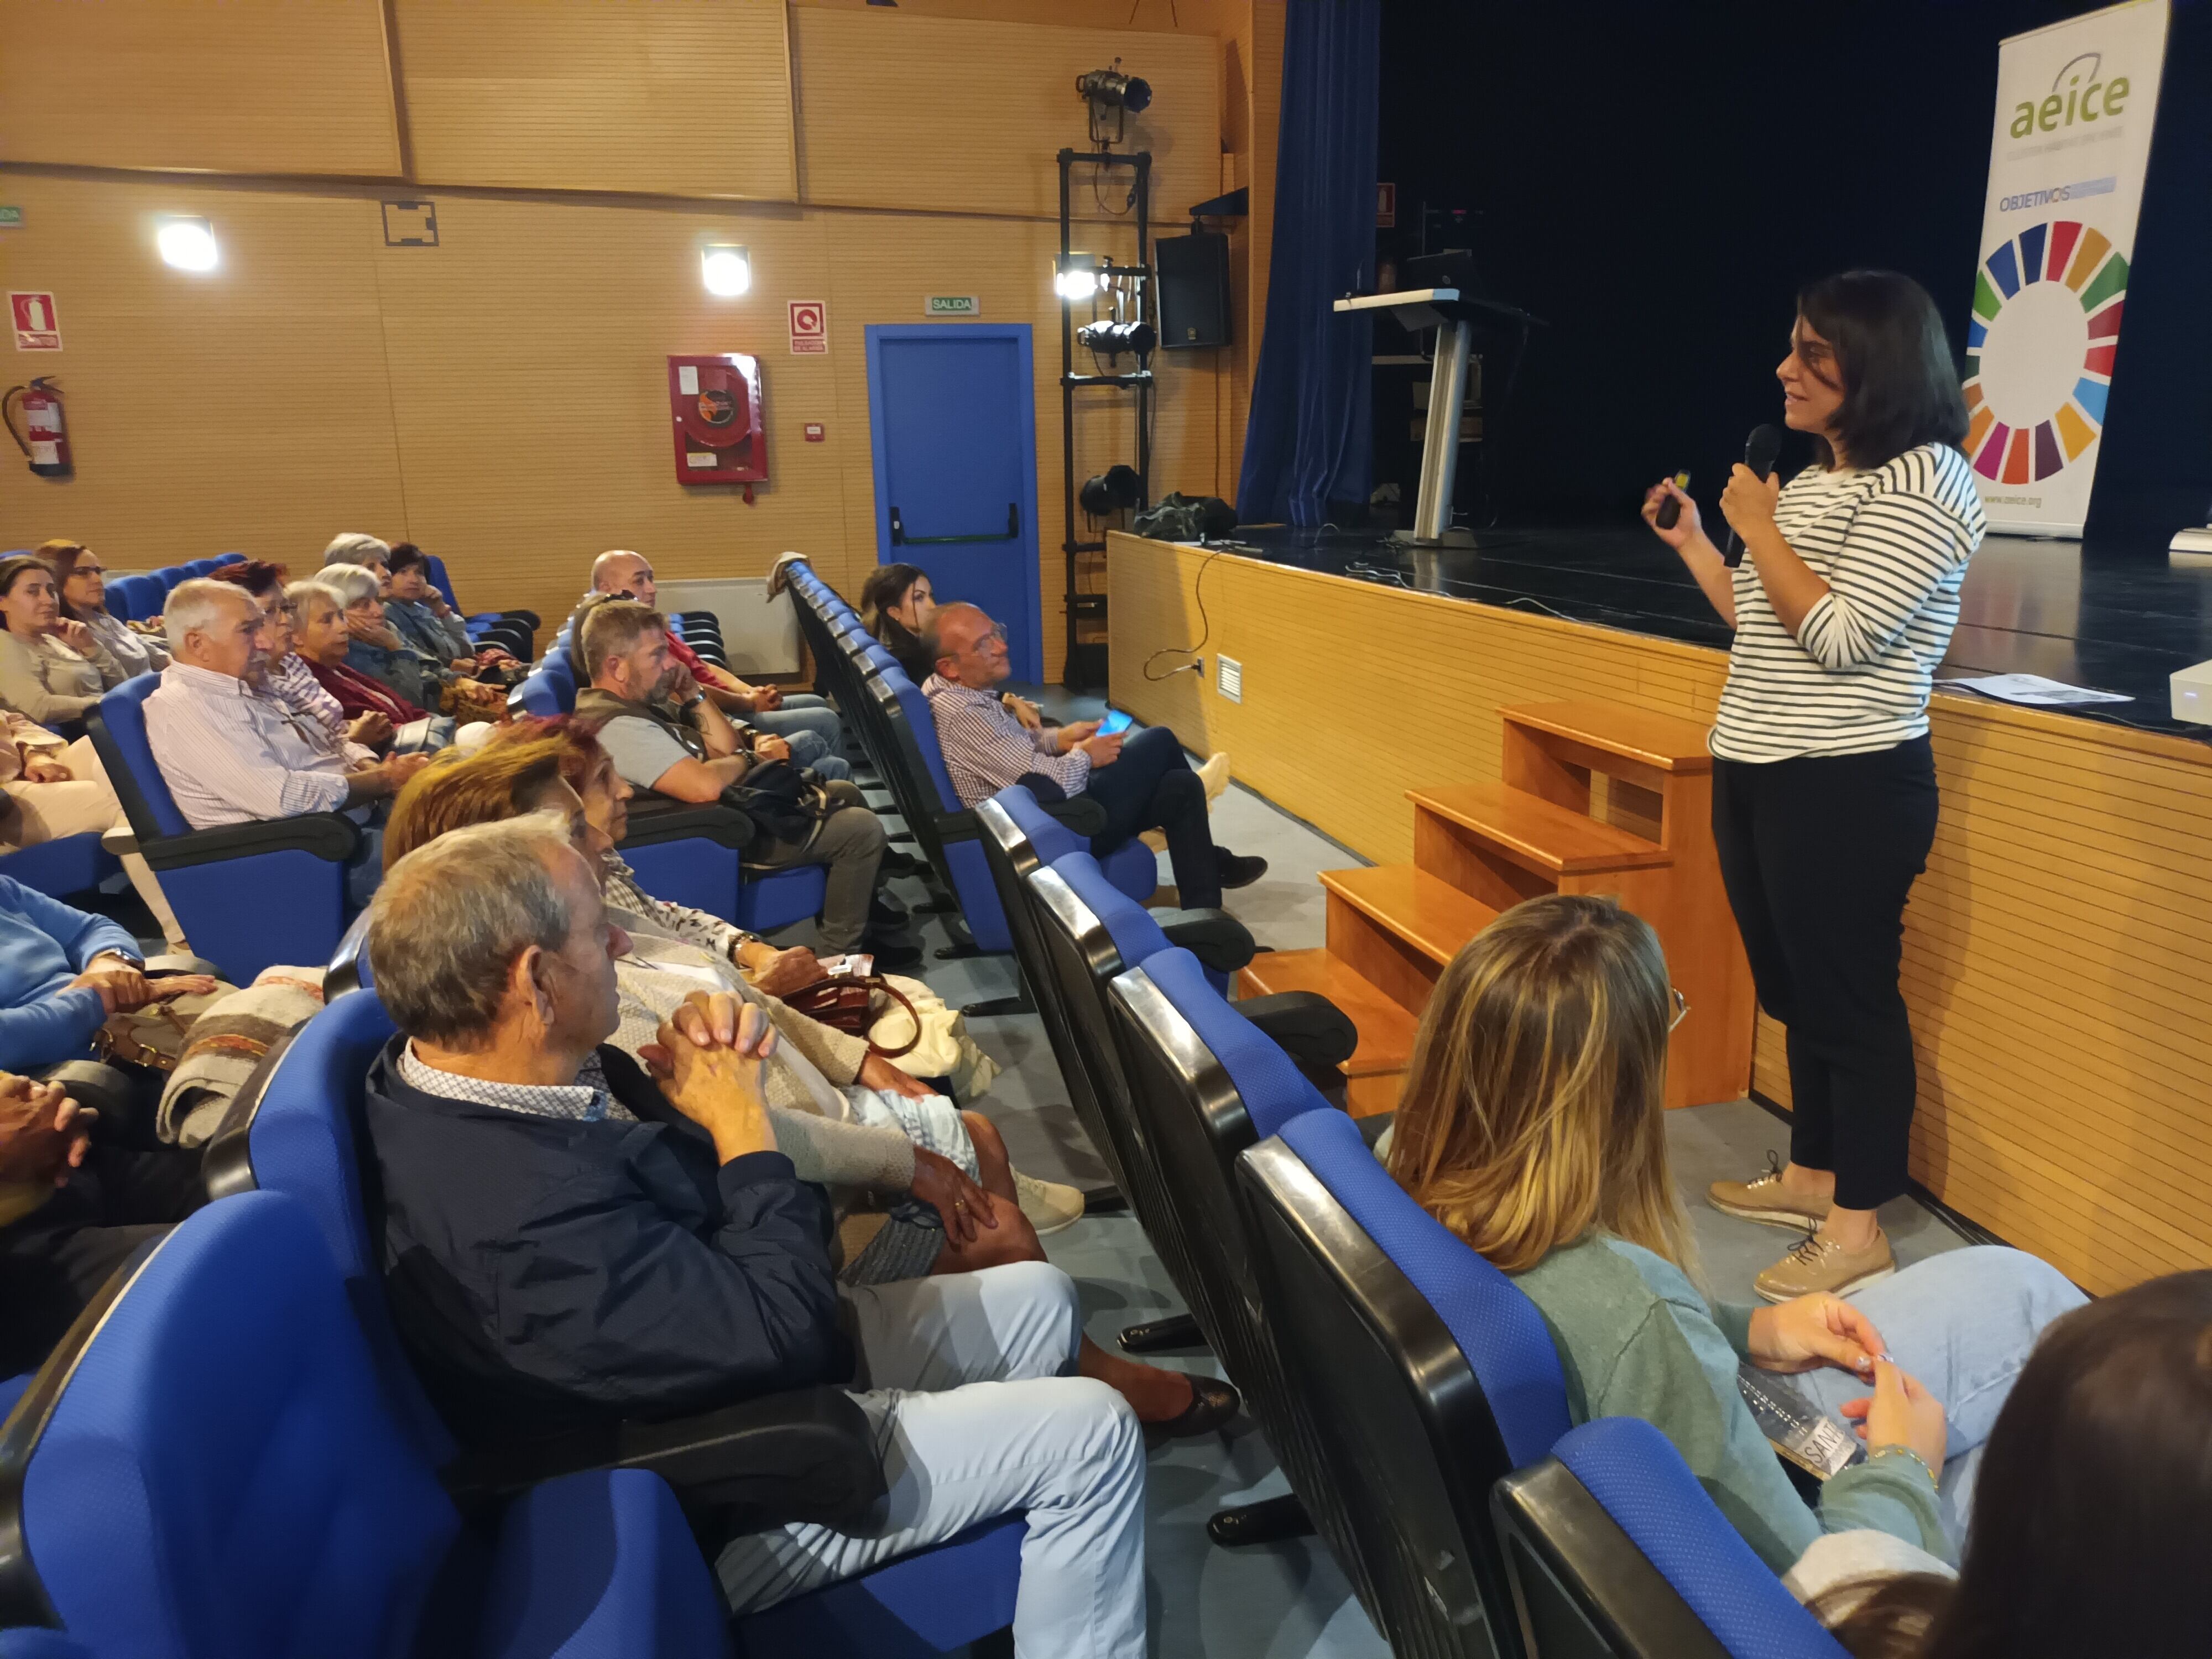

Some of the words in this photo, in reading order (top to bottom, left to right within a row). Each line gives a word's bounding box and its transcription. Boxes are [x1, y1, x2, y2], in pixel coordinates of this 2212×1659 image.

[2010, 75, 2130, 139] aeice
[2000, 185, 2071, 212] OBJETIVOS
[933, 299, 972, 310] SALIDA
